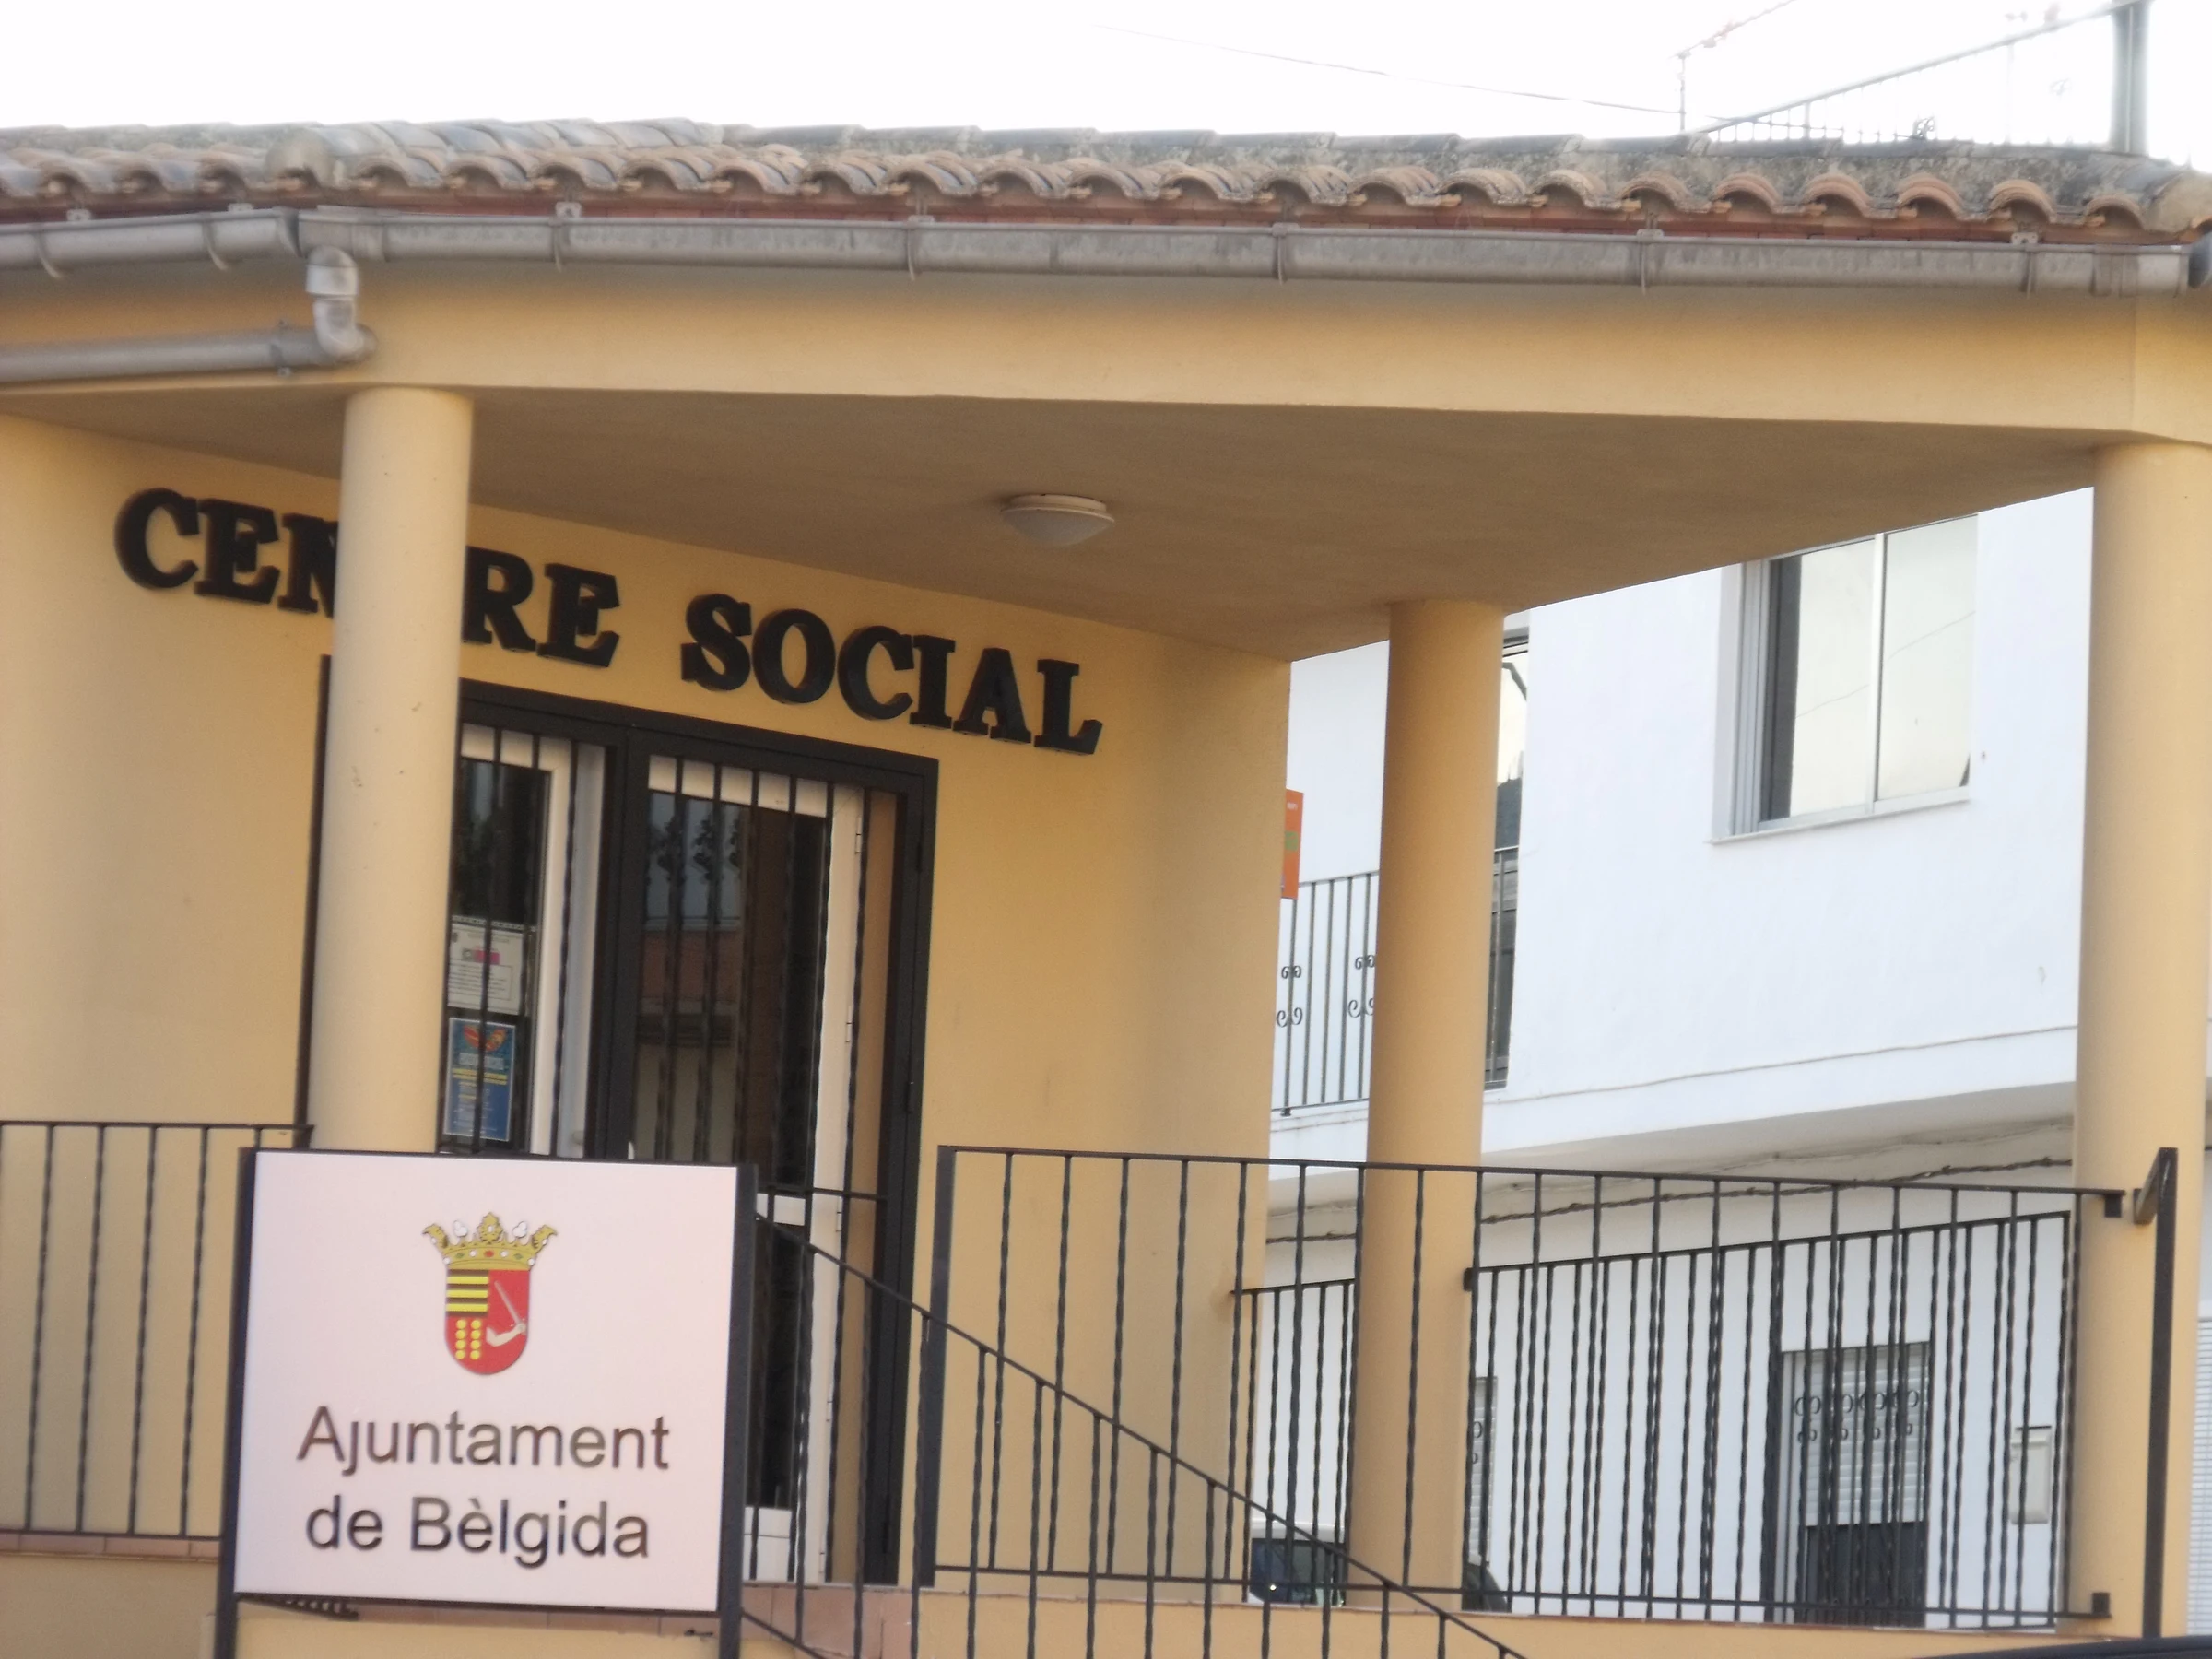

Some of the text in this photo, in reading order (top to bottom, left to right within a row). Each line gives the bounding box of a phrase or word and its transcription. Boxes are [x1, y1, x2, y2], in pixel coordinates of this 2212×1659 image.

[114, 488, 1103, 756] CENRE SOCIAL
[296, 1406, 671, 1477] Ajuntament
[305, 1494, 650, 1570] de Bèlgida
